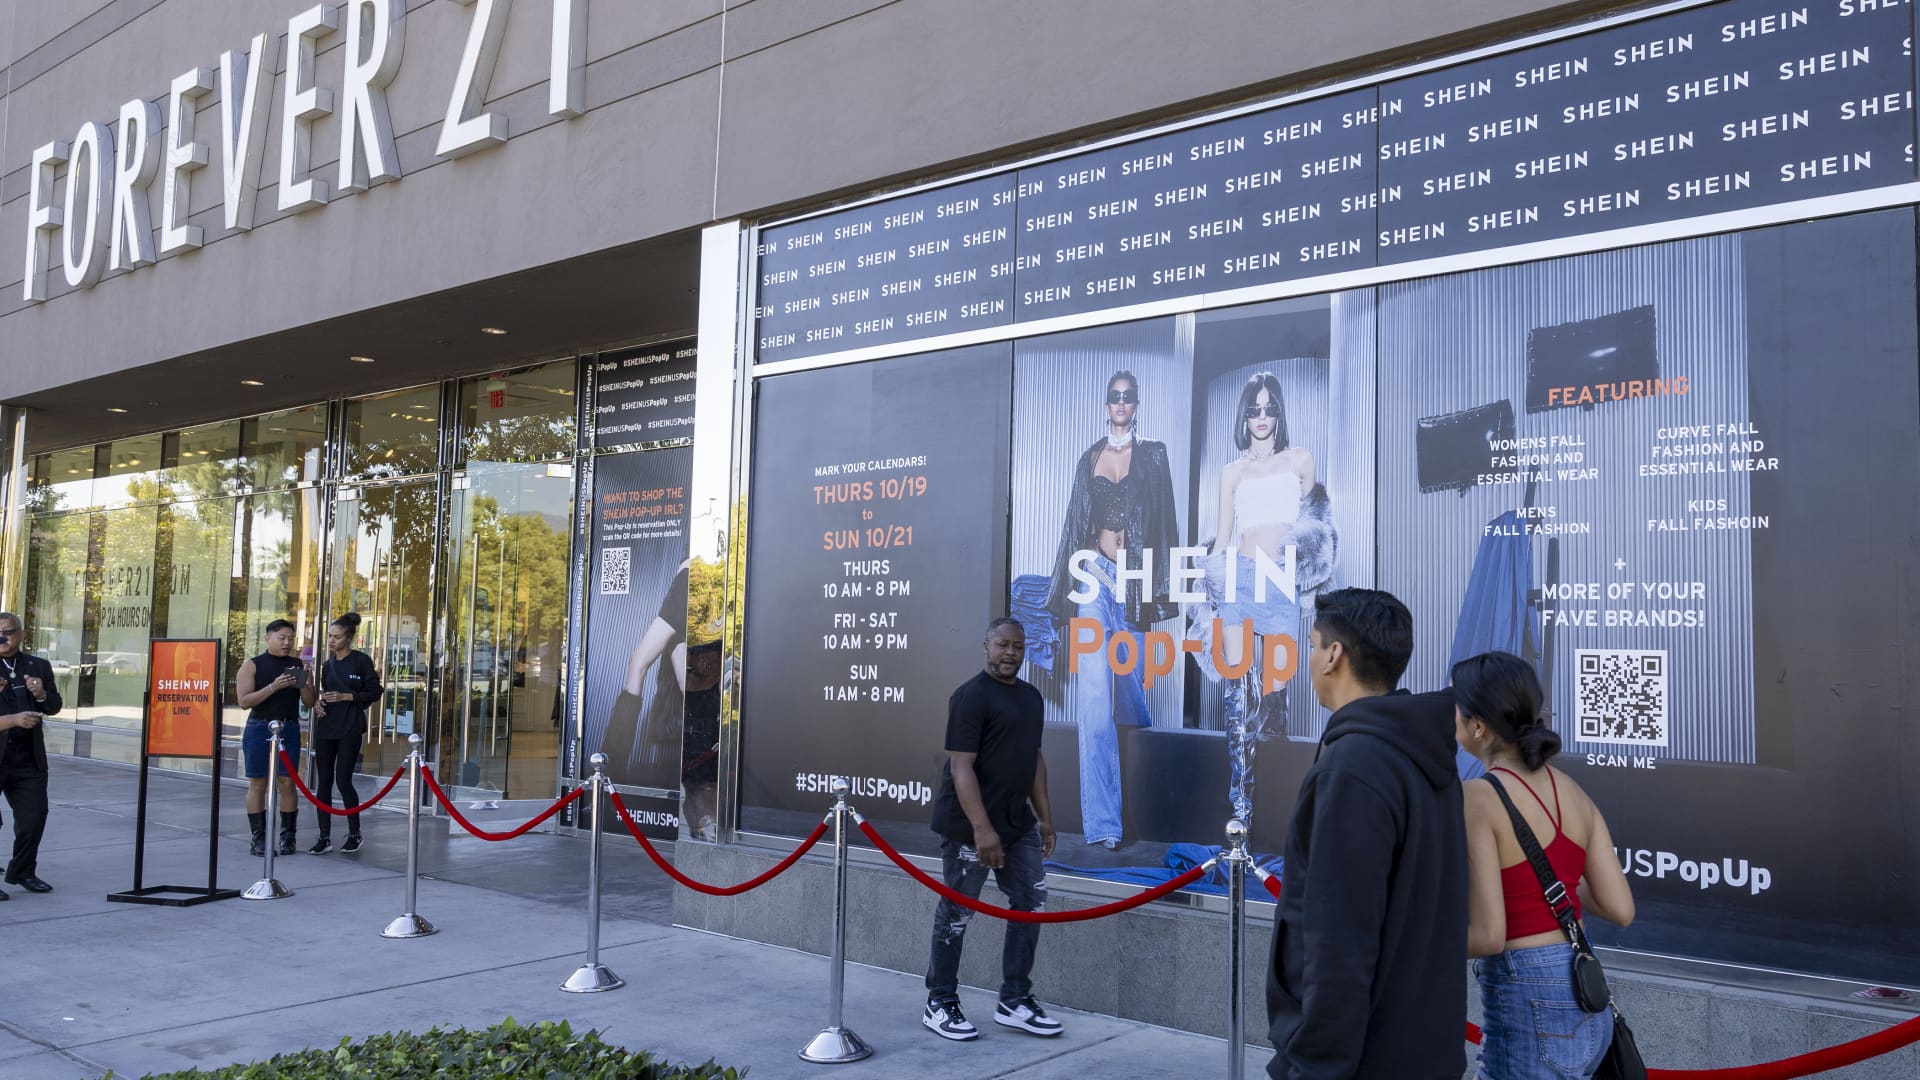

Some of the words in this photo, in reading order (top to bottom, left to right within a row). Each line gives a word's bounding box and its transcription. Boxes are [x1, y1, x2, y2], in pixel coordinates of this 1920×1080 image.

[788, 232, 822, 249] SHEIN
[835, 221, 871, 239] SHEIN
[884, 210, 923, 229] SHEIN
[937, 198, 978, 218] SHEIN
[993, 181, 1042, 206] SHEIN
[1058, 167, 1105, 188] SHEIN
[1122, 152, 1172, 175] SHEIN
[1191, 137, 1244, 160] SHEIN
[1264, 120, 1321, 145] SHEIN
[1342, 99, 1401, 128] SHEIN
[1424, 79, 1490, 107] SHEIN
[1515, 57, 1587, 87] SHEIN
[1614, 33, 1692, 65] SHEIN
[1722, 8, 1807, 42] SHEIN
[23, 0, 406, 303] FOREVER
[764, 269, 798, 285] SHEIN
[810, 260, 845, 277] SHEIN
[858, 249, 895, 267] SHEIN
[909, 239, 949, 257] SHEIN
[963, 227, 1006, 247] SHEIN
[1027, 211, 1072, 231] SHEIN
[1089, 198, 1137, 219] SHEIN
[1155, 184, 1206, 206] SHEIN
[1225, 169, 1281, 193] SHEIN
[1301, 153, 1361, 178] SHEIN
[1380, 133, 1444, 159] SHEIN
[1468, 114, 1537, 142] SHEIN
[1563, 93, 1638, 123] SHEIN
[1667, 71, 1748, 102] SHEIN
[1779, 46, 1869, 80] SHEIN
[785, 297, 820, 313] SHEIN
[832, 288, 869, 305] SHEIN
[882, 279, 921, 296] SHEIN
[935, 269, 976, 287] SHEIN
[991, 254, 1040, 277] SHEIN
[1056, 242, 1103, 263] SHEIN
[1120, 230, 1170, 251] SHEIN
[1189, 217, 1242, 239] SHEIN
[1262, 203, 1320, 226] SHEIN
[1341, 186, 1400, 212] SHEIN
[1424, 169, 1490, 195] SHEIN
[1515, 151, 1587, 178] SHEIN
[1614, 131, 1693, 160] SHEIN
[1722, 110, 1808, 141] SHEIN
[762, 333, 795, 348] SHEIN
[807, 326, 842, 341] SHEIN
[855, 317, 893, 334] SHEIN
[907, 309, 947, 326] SHEIN
[961, 300, 1004, 317] SHEIN
[1025, 286, 1070, 304] SHEIN
[1087, 275, 1135, 295] SHEIN
[1153, 264, 1205, 284] SHEIN
[1224, 252, 1280, 273] SHEIN
[1300, 239, 1360, 261] SHEIN
[1380, 222, 1444, 246] SHEIN
[1468, 206, 1538, 232] SHEIN
[1564, 190, 1639, 216] SHEIN
[1667, 171, 1749, 200] SHEIN
[1781, 151, 1870, 181] SHEIN
[1548, 376, 1689, 407] FEATURING
[1658, 425, 1711, 440] CURVE
[1716, 422, 1758, 436] FALL
[1490, 436, 1547, 451] WOMENS
[1551, 434, 1585, 447] FALL
[1652, 442, 1725, 458] FASHION
[1730, 440, 1764, 454] AND
[815, 465, 840, 476] MARK
[842, 462, 866, 474] YOUR
[868, 456, 927, 471] CALENDARS!
[1491, 453, 1549, 468] FASHION
[1553, 452, 1584, 464] AND
[1640, 461, 1726, 477] ESSENTIAL
[1731, 458, 1778, 472] WEAR
[1477, 471, 1552, 485] ESSENTIAL
[1556, 468, 1598, 481] WEAR
[603, 492, 627, 504] WANT
[629, 491, 640, 502] TO
[642, 489, 664, 501] SHOP
[666, 488, 683, 498] THE
[814, 481, 874, 505] THURS
[880, 476, 927, 500] 10/19
[603, 508, 628, 520] SHEIN
[630, 506, 662, 517] POP-UP
[665, 504, 683, 515] IRL?
[862, 509, 873, 520] to
[1517, 507, 1556, 518] MENS
[1688, 500, 1726, 512] KIDS
[1484, 525, 1520, 537] FALL
[1525, 522, 1590, 535] FASHION
[1648, 519, 1688, 532] FALL
[1694, 516, 1769, 530] FASHOIN
[824, 530, 859, 550] SUN
[866, 525, 913, 548] 10/21
[843, 560, 890, 576] THURS
[1067, 544, 1297, 604] SHEIN
[824, 583, 837, 598] 10
[841, 582, 862, 598] AM
[876, 581, 885, 596] 8
[890, 580, 910, 596] PM
[1541, 583, 1600, 600] MORE
[1607, 582, 1635, 599] OF
[1641, 582, 1706, 600] YOUR
[834, 613, 856, 628] FRI
[869, 612, 897, 628] SAT
[1542, 610, 1597, 627] FAVE
[1605, 610, 1704, 627] BRANDS!
[824, 635, 837, 650] 10
[841, 634, 861, 649] AM
[874, 634, 883, 649] 9
[887, 634, 908, 649] PM
[1069, 616, 1298, 696] Pop-Up
[850, 665, 878, 680] SUN
[158, 680, 190, 690] SHEIN
[193, 680, 210, 690] VIP
[157, 694, 208, 702] RESERVATION
[824, 686, 833, 701] 11
[837, 686, 857, 701] AM
[871, 687, 880, 702] 8
[884, 687, 904, 702] PM
[173, 706, 190, 715] LINE
[1587, 754, 1628, 768] SCAN
[1633, 756, 1656, 770] ME
[616, 808, 679, 828] #HEINUSPo
[1614, 847, 1771, 895] USPopUp
